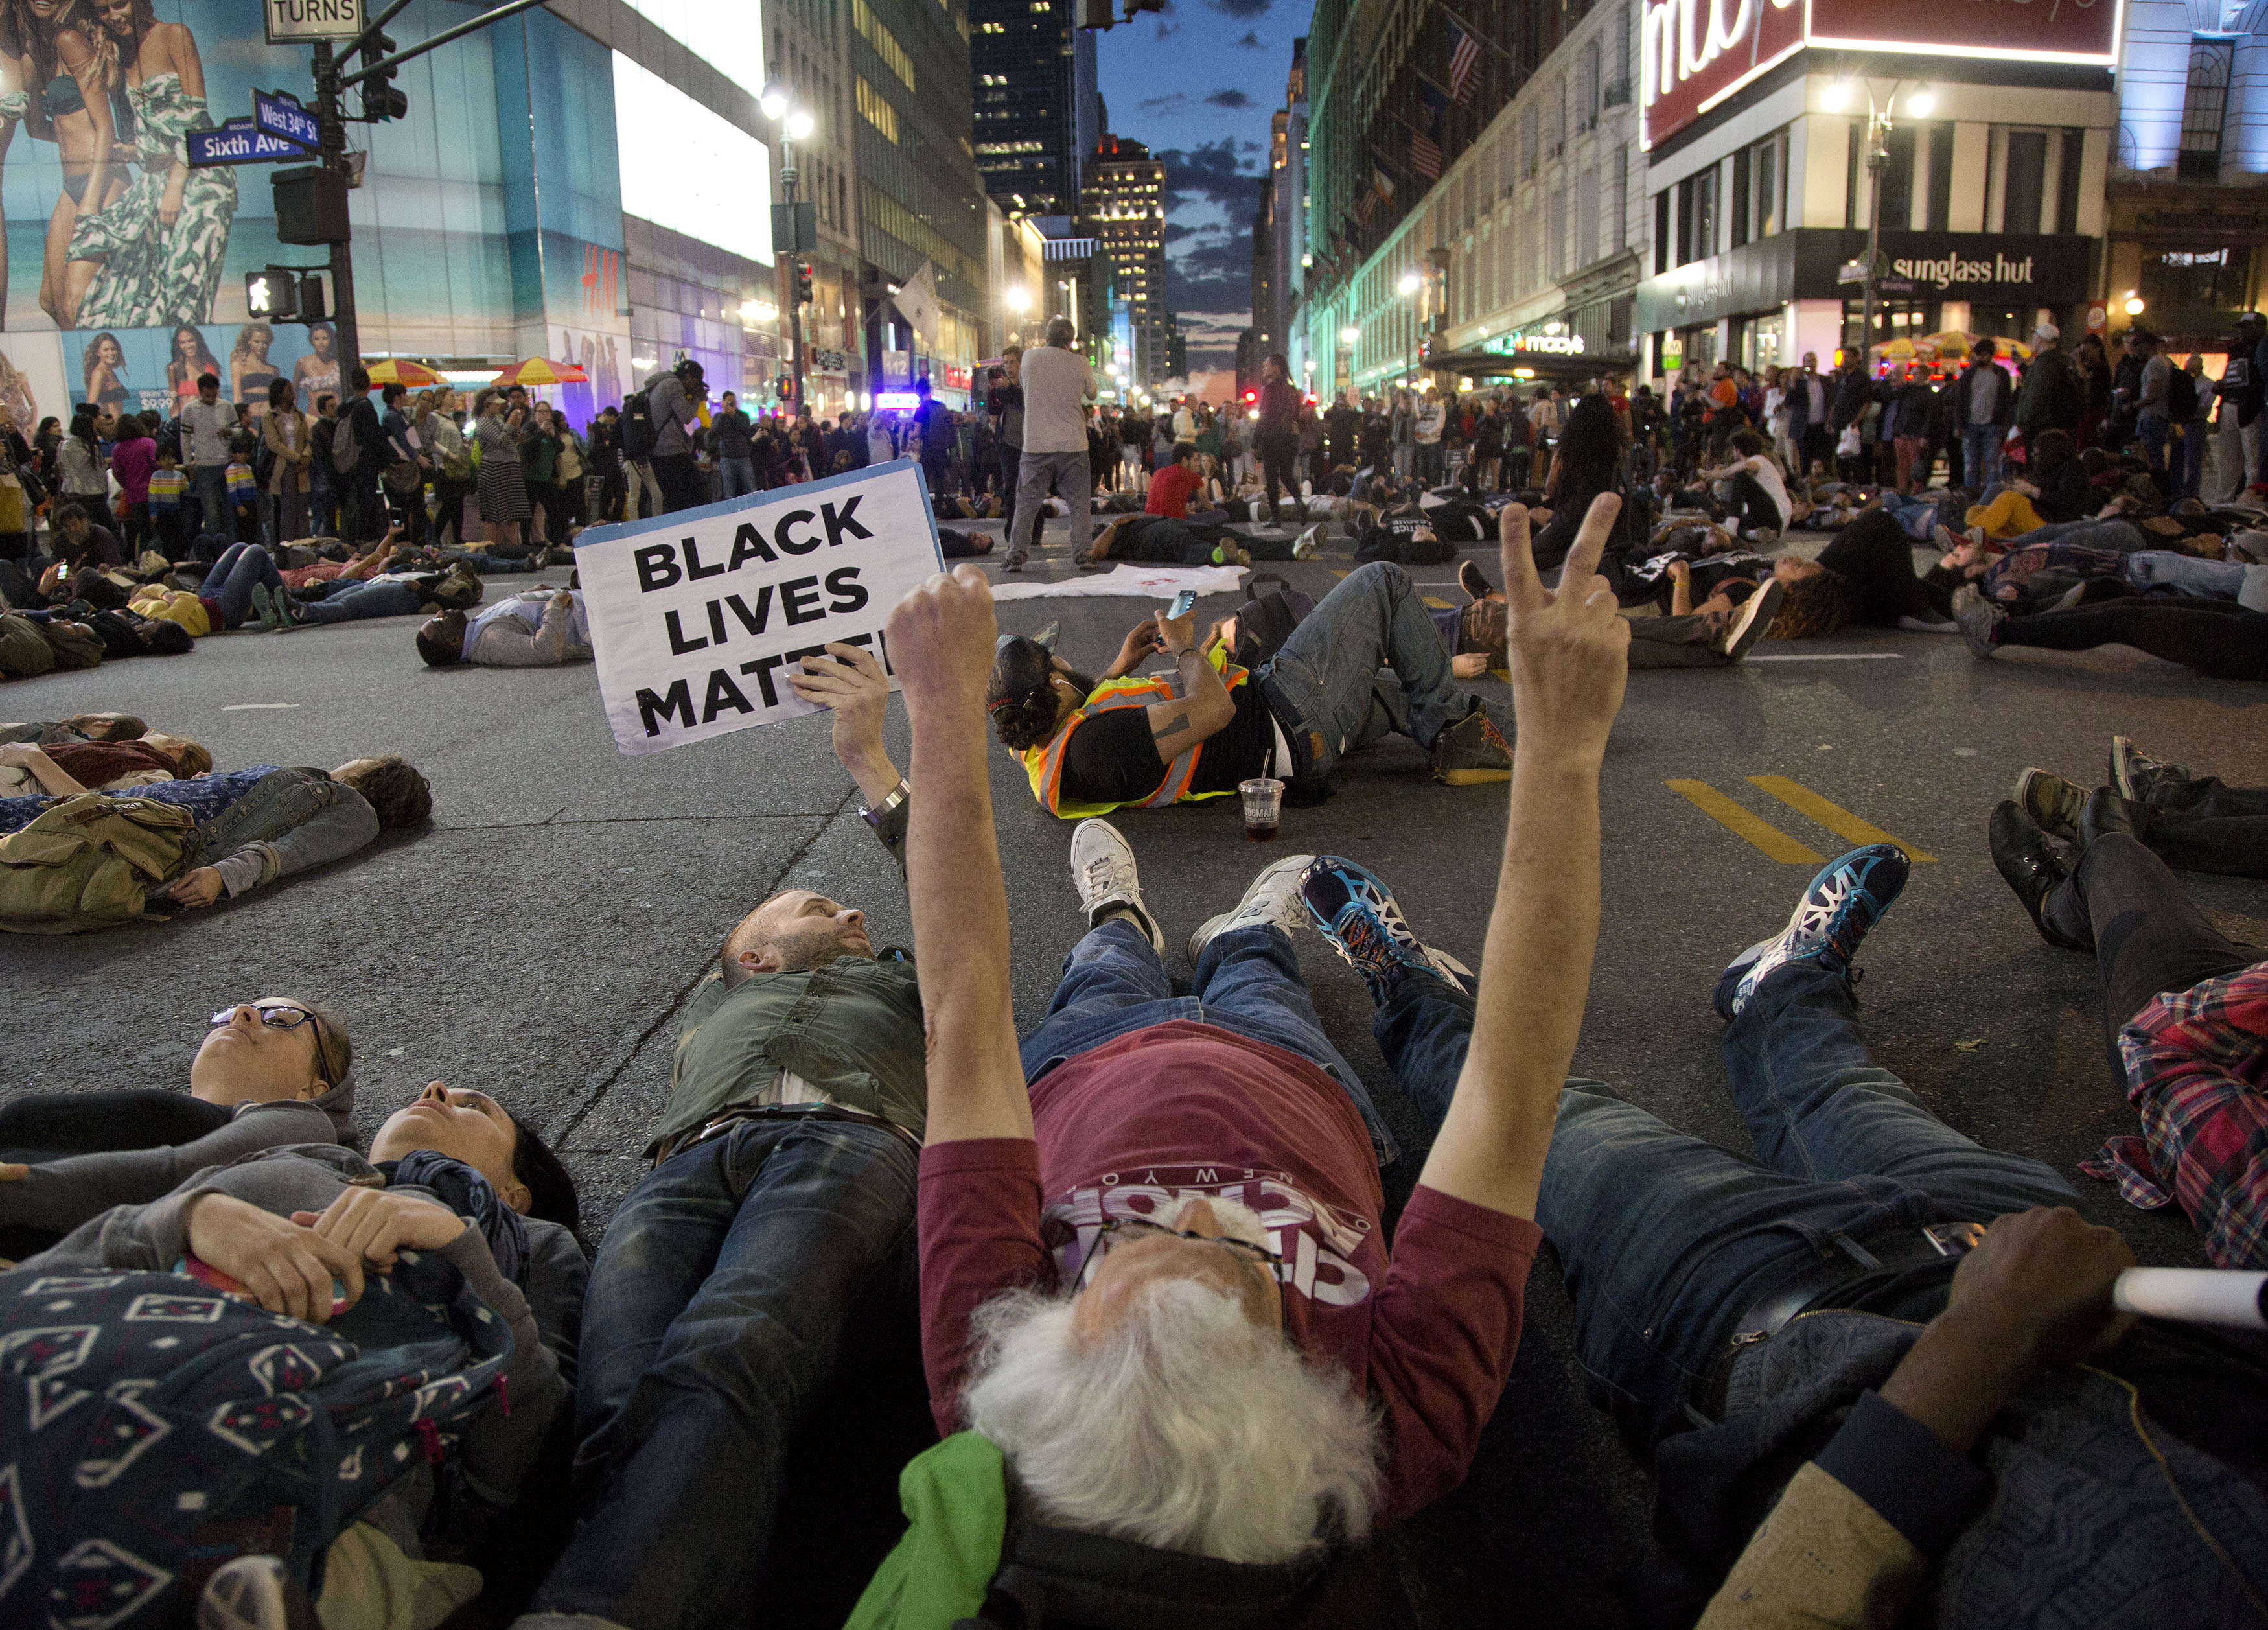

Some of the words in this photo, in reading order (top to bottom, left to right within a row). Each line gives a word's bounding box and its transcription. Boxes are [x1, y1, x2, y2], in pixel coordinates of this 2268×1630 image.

[274, 0, 354, 22] TURNS
[260, 102, 287, 130] West
[288, 113, 306, 135] 34th
[306, 119, 318, 141] St
[204, 134, 250, 157] Sixth
[255, 134, 290, 153] Ave
[1893, 251, 1992, 290] sunglass
[1996, 253, 2033, 283] hut
[885, 360, 907, 375] 112
[634, 495, 874, 593] BLACK
[665, 566, 869, 656] LIVES
[635, 629, 895, 738] MAT
